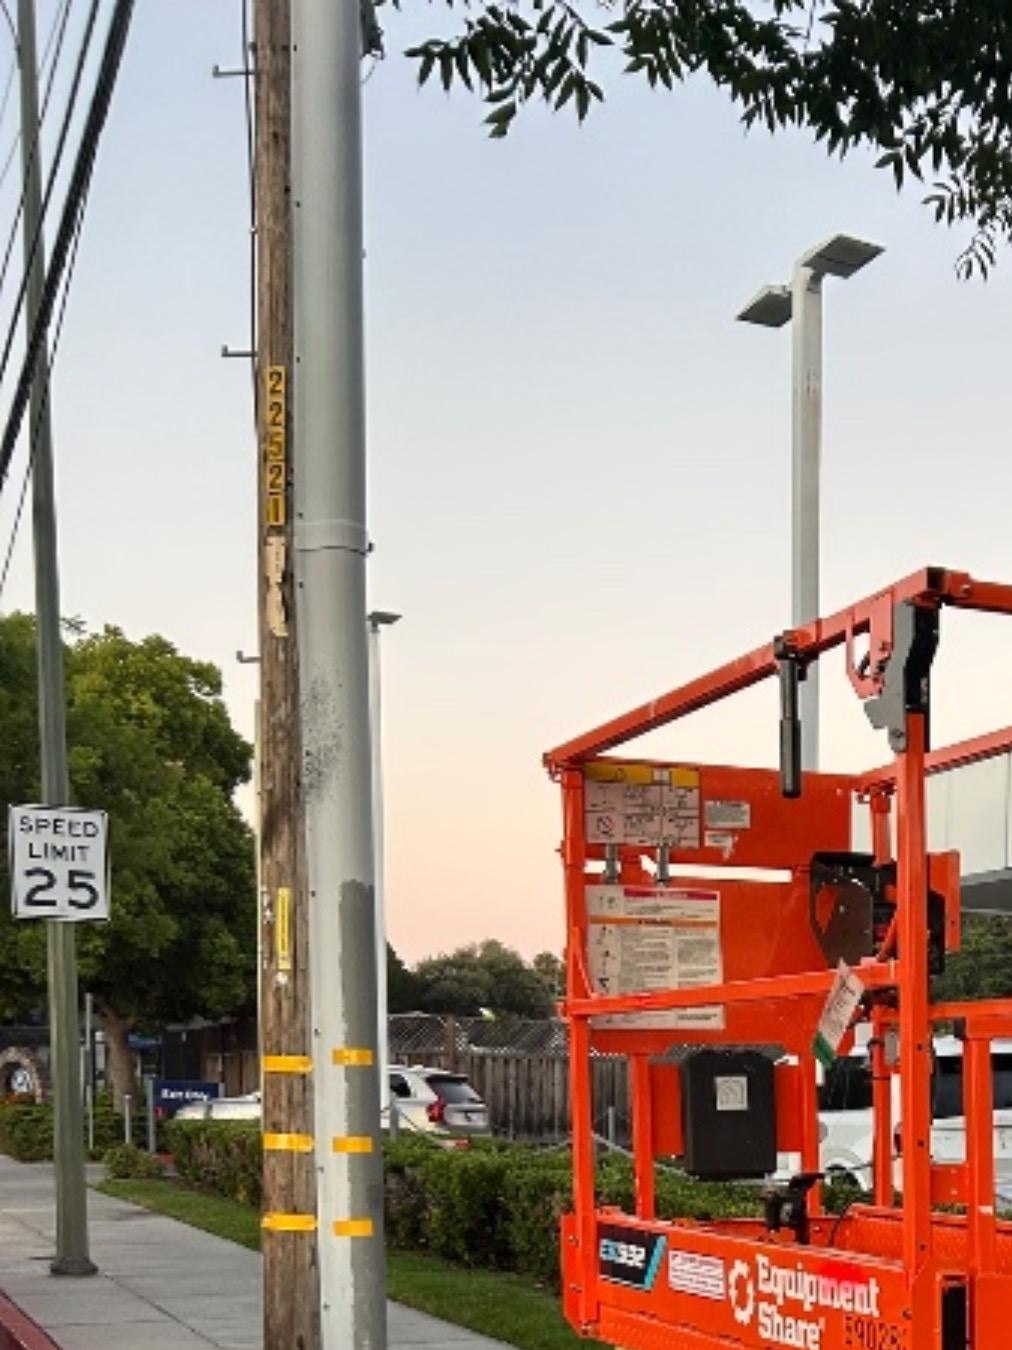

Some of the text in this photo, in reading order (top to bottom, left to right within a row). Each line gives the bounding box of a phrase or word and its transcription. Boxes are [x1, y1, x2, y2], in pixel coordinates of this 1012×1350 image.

[20, 816, 99, 838] SPEED
[29, 842, 90, 861] LIMIT
[24, 866, 99, 909] 25
[756, 1254, 880, 1317] Equipment
